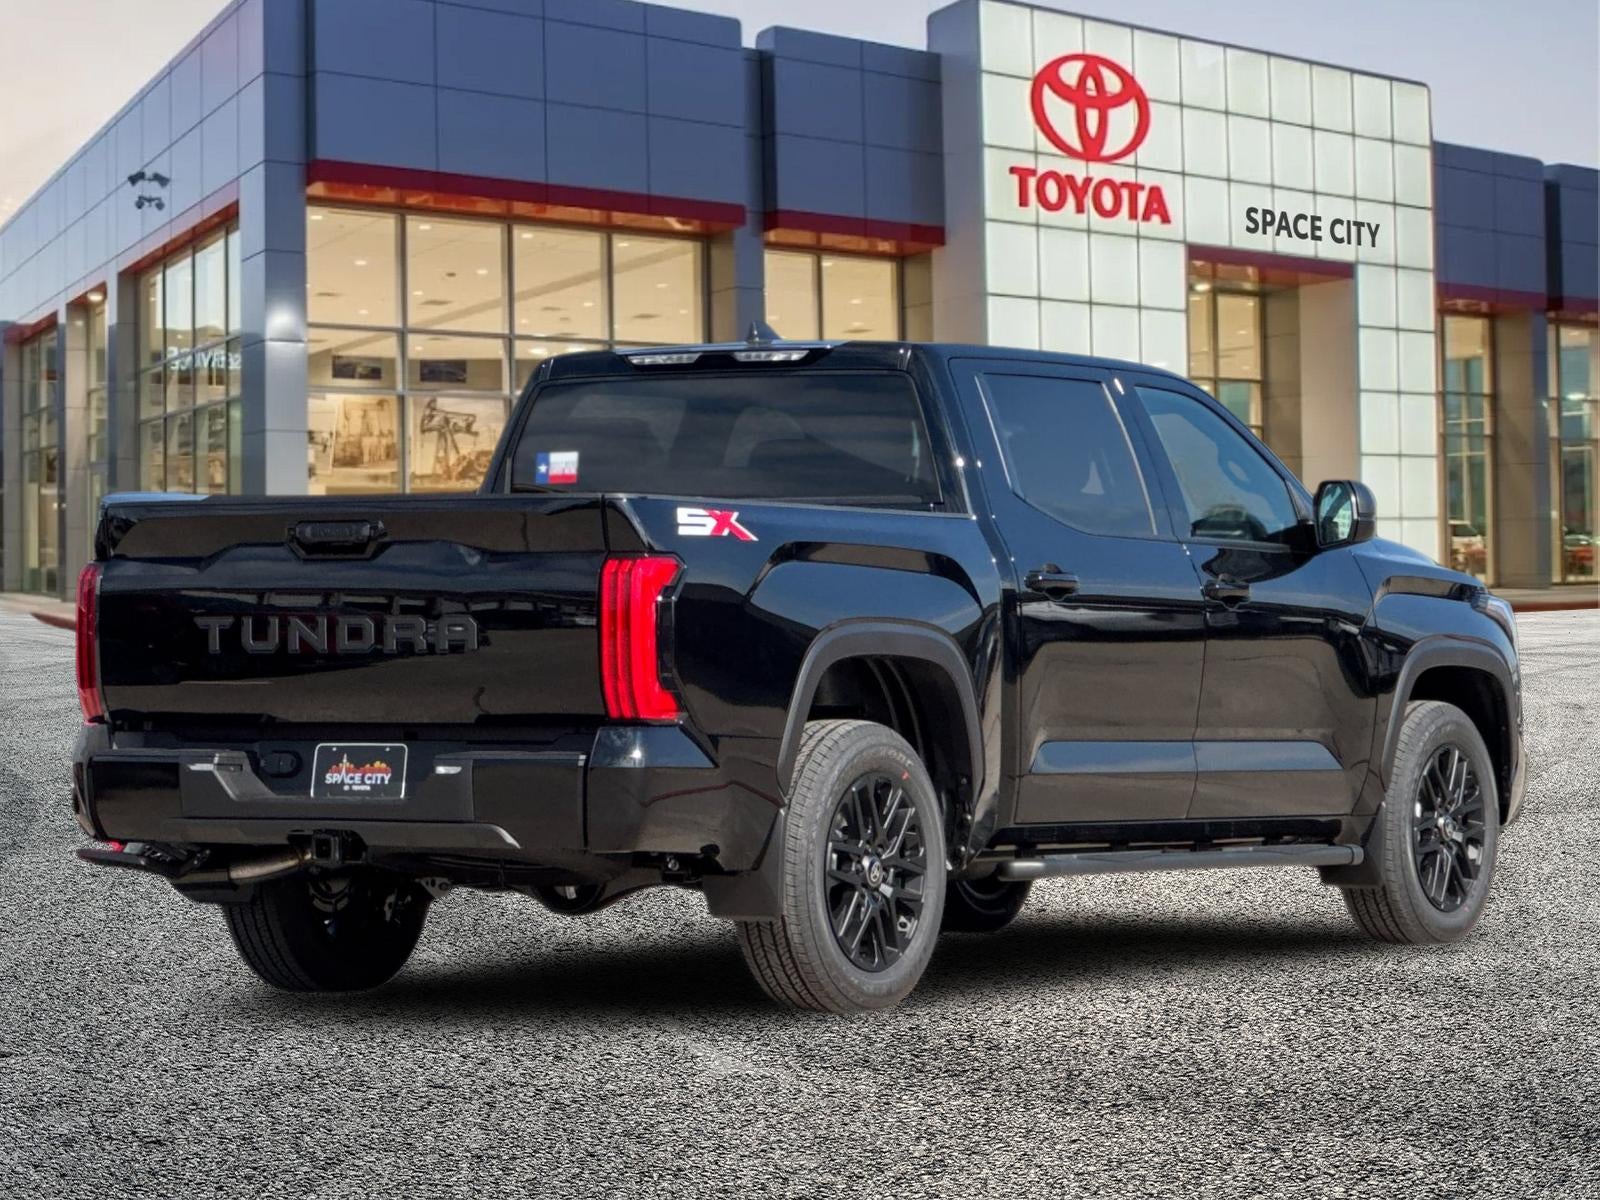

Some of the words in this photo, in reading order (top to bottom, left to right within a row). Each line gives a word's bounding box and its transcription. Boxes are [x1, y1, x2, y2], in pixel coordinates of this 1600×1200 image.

[1009, 166, 1172, 225] TOYOTA
[1245, 206, 1323, 242] SPACE
[1329, 217, 1381, 248] CITY
[193, 615, 479, 654] TUNDRA
[325, 772, 362, 785] SPACE
[364, 772, 391, 785] CITY
